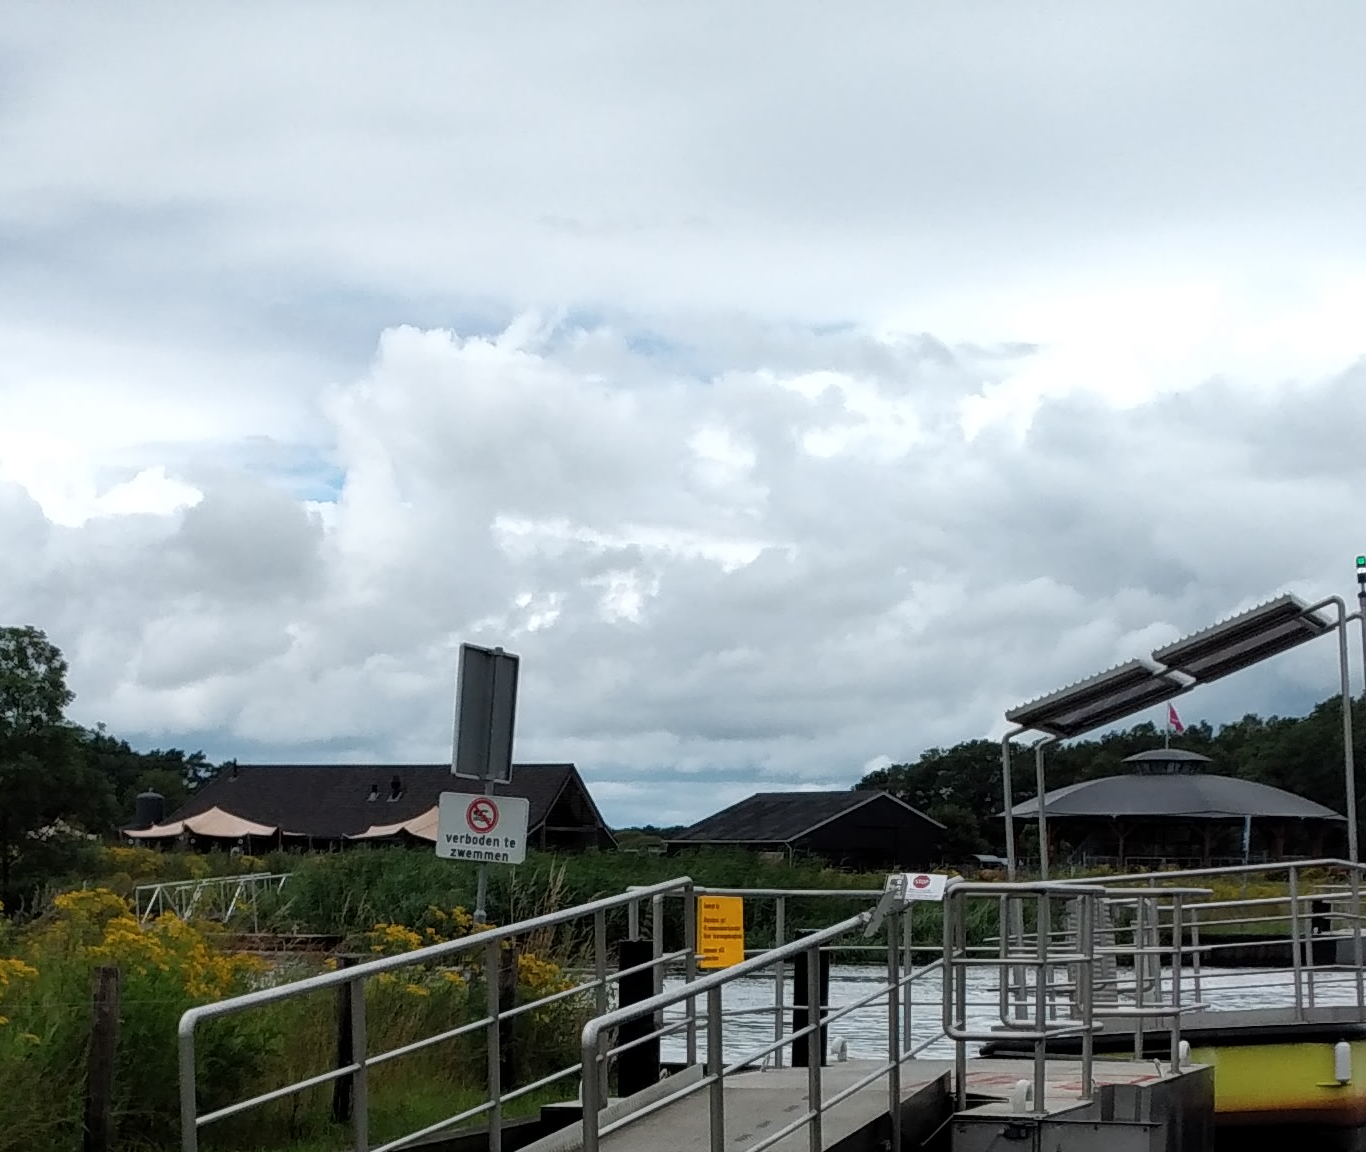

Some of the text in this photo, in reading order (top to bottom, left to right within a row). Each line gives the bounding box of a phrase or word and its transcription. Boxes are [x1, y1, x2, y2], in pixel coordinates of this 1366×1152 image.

[446, 833, 516, 848] verboden te
[450, 848, 509, 862] zwemmen
